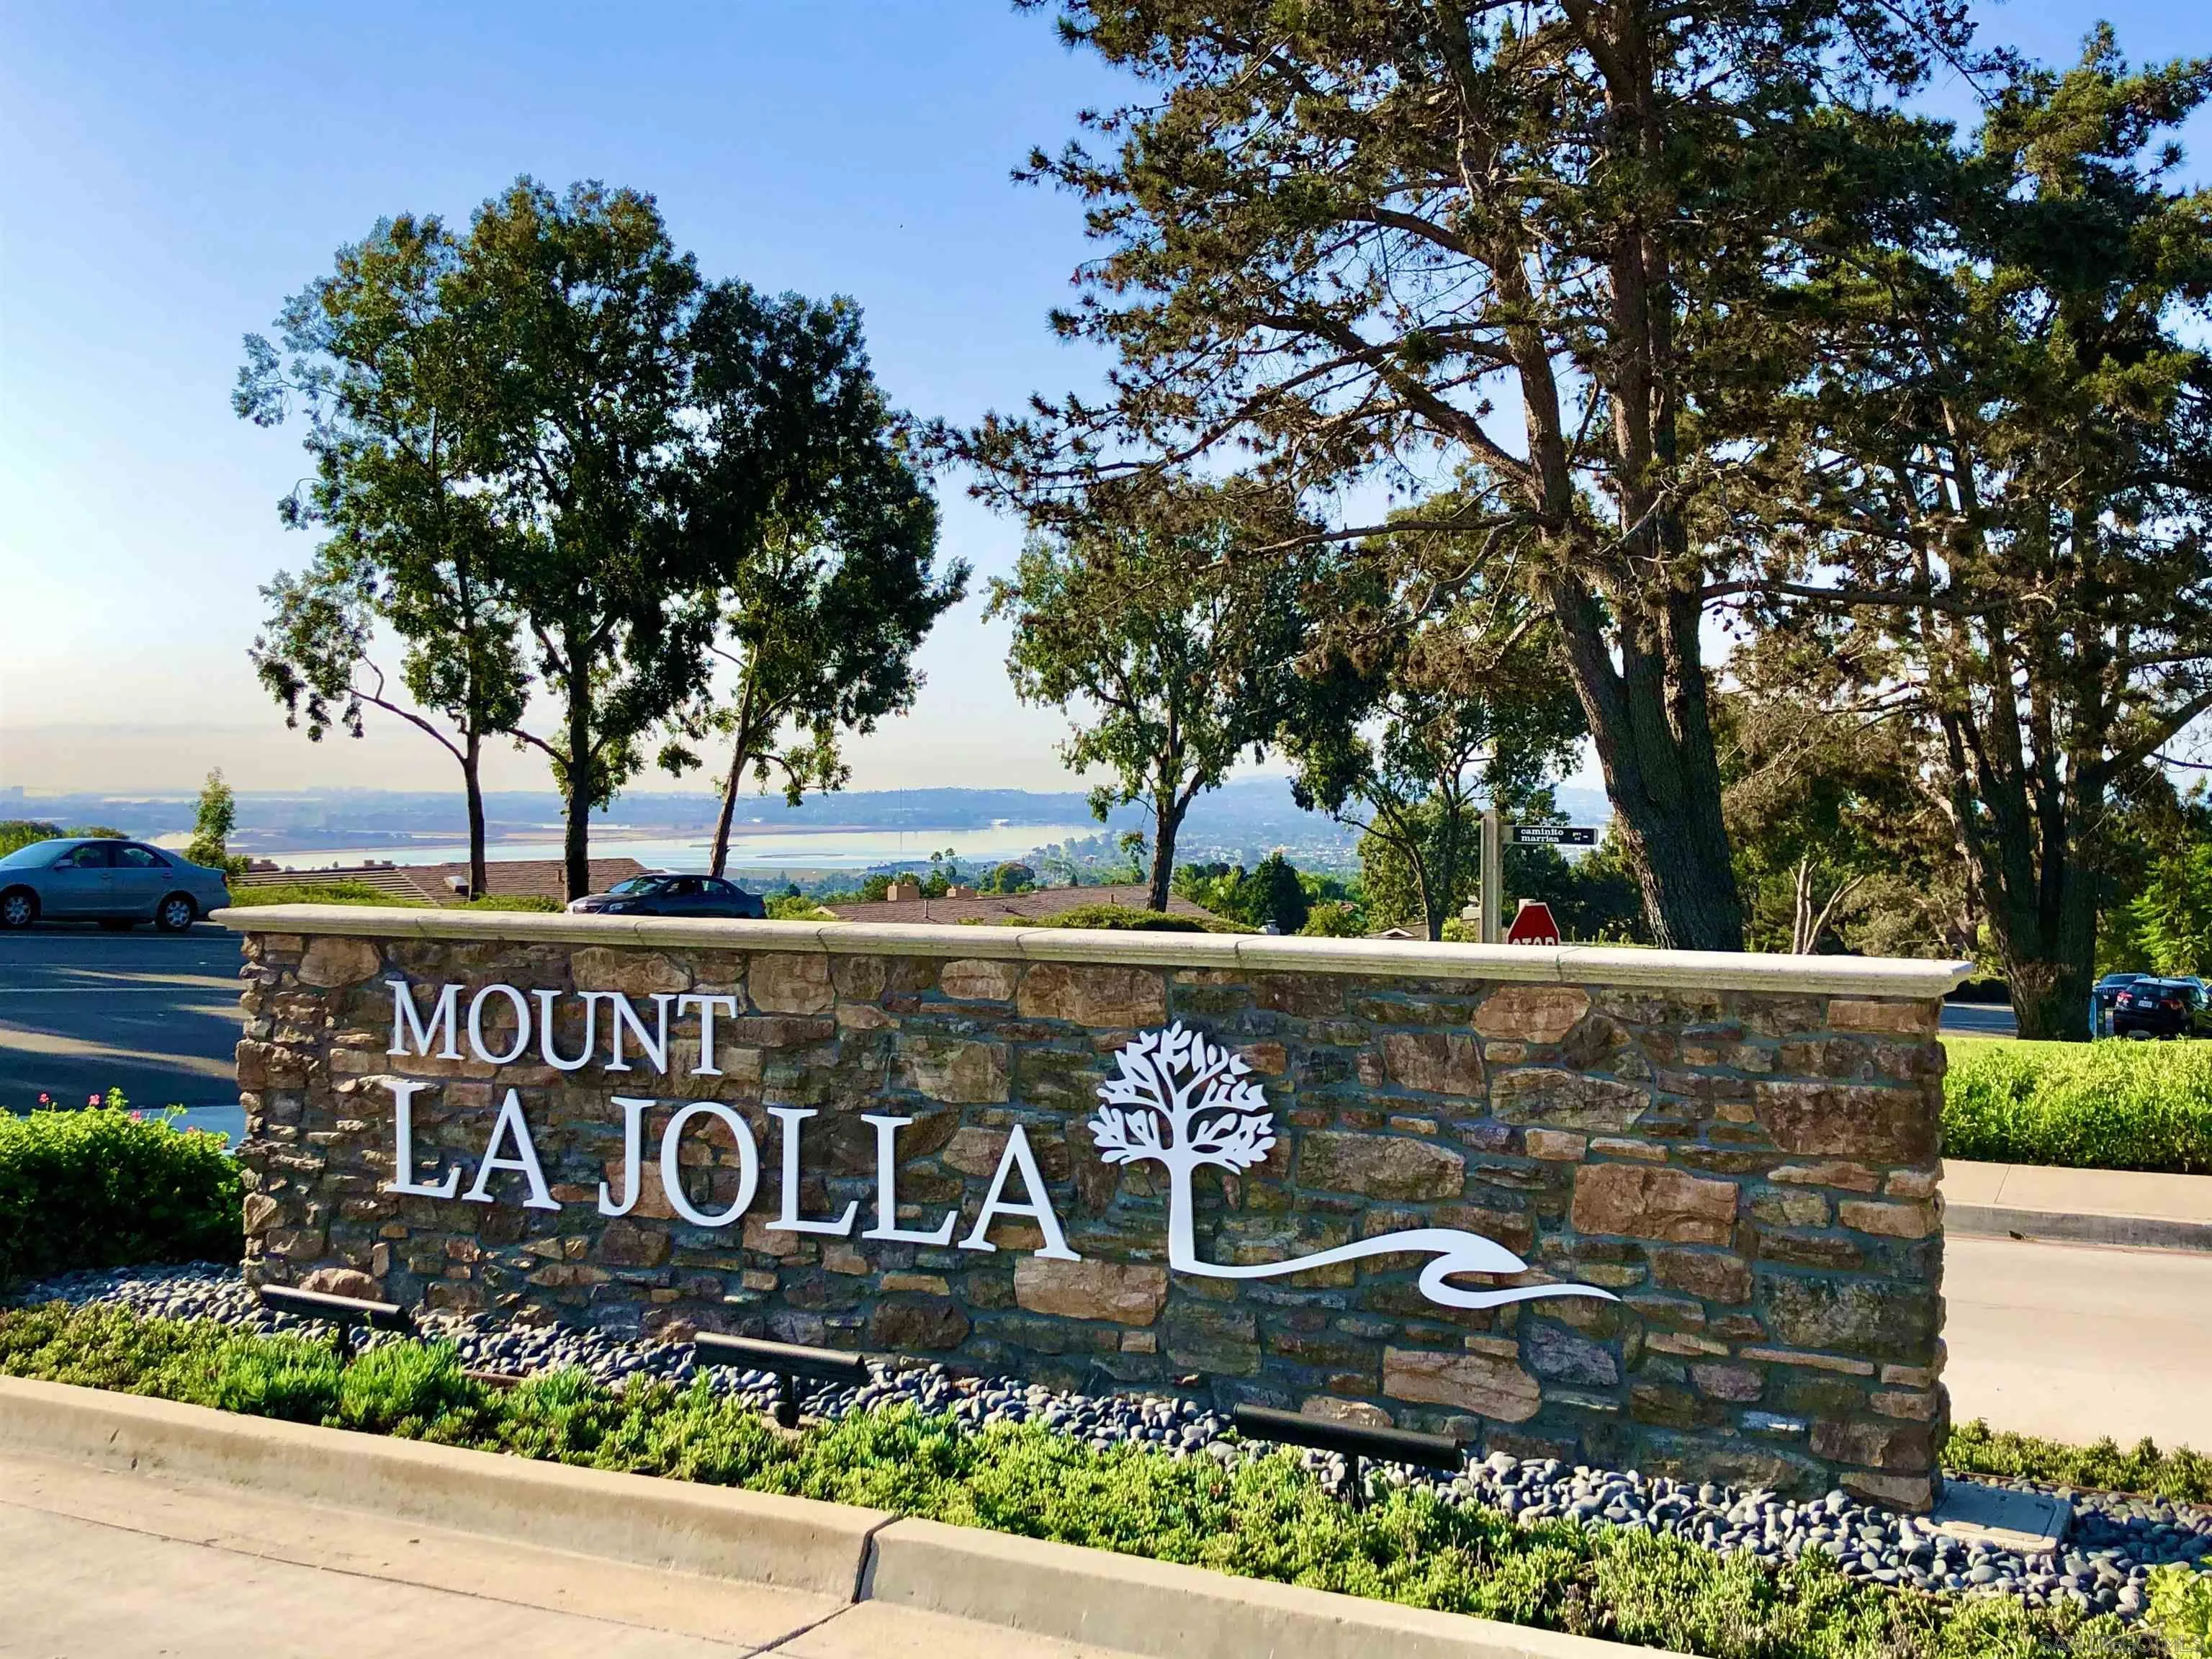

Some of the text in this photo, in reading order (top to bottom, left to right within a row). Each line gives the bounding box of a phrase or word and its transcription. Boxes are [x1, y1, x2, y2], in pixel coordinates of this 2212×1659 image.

[385, 980, 737, 1076] MOUNT
[383, 1079, 1082, 1262] LA JOLLA
